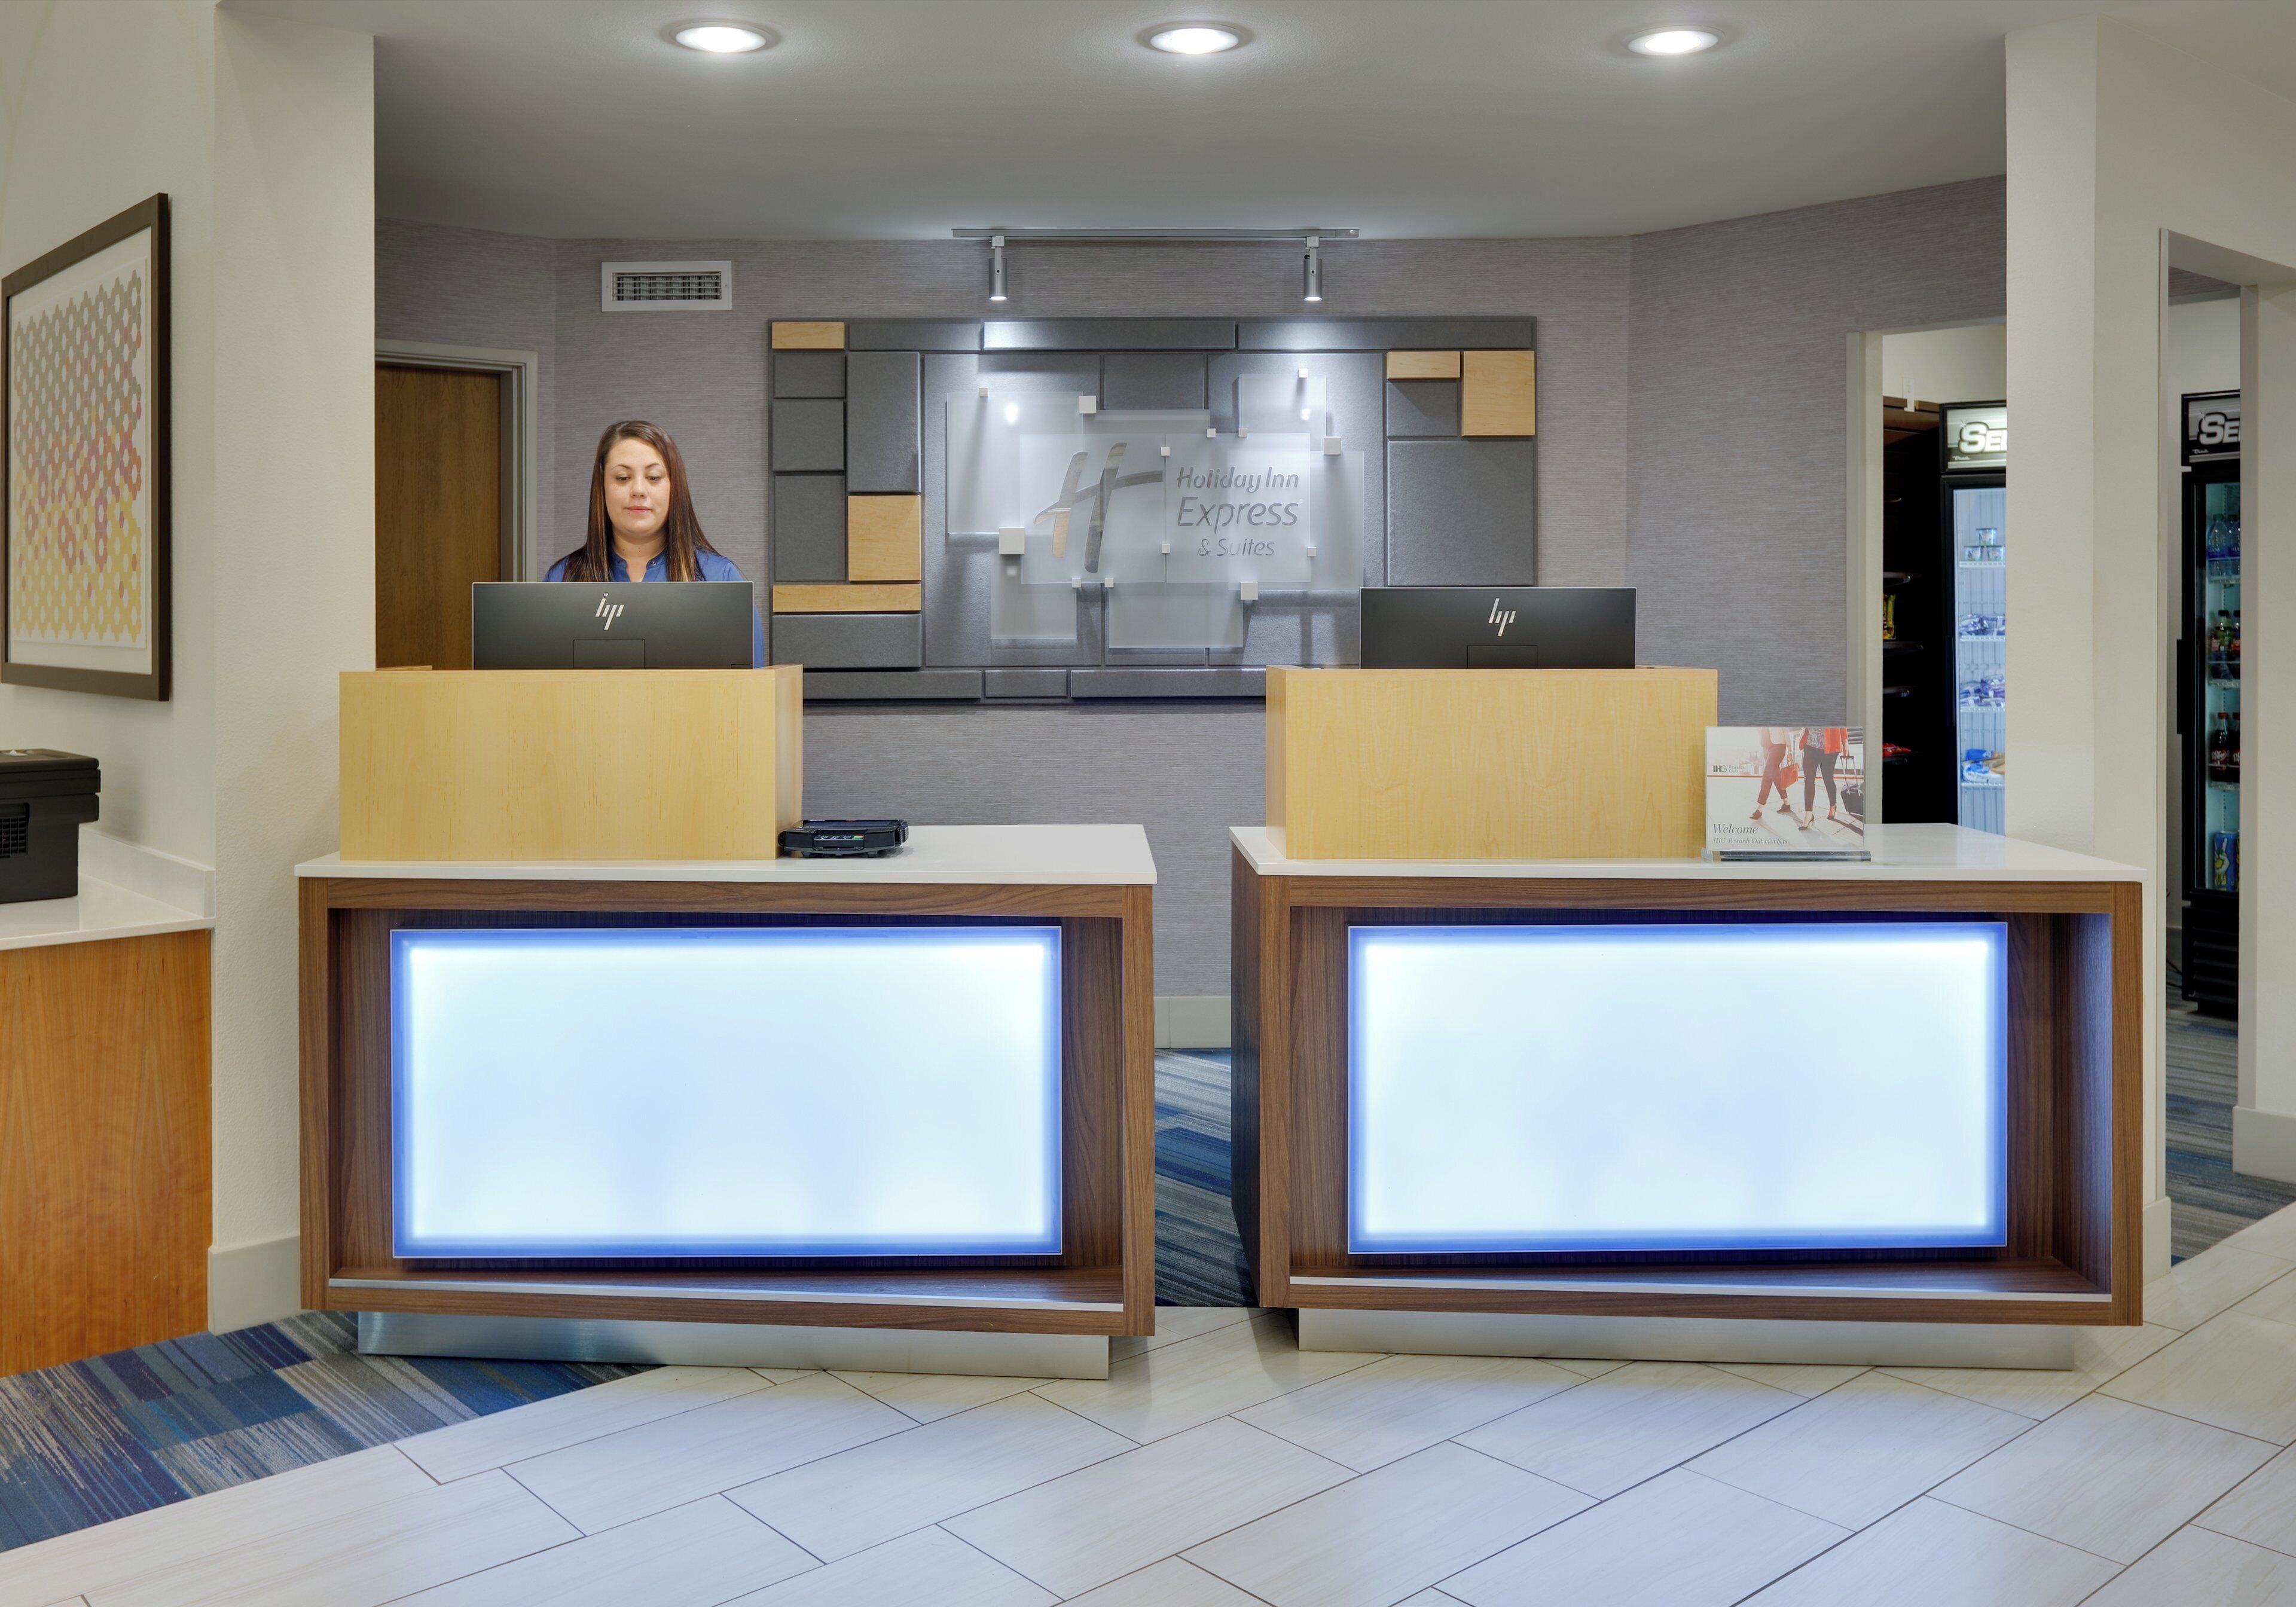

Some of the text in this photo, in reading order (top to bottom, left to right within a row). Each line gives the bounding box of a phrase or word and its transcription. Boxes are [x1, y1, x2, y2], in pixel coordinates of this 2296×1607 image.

[1177, 466, 1299, 493] Holiday Inn
[1177, 496, 1299, 534] Express
[1198, 538, 1275, 557] & Suites
[1713, 823, 1758, 834] Welcome
